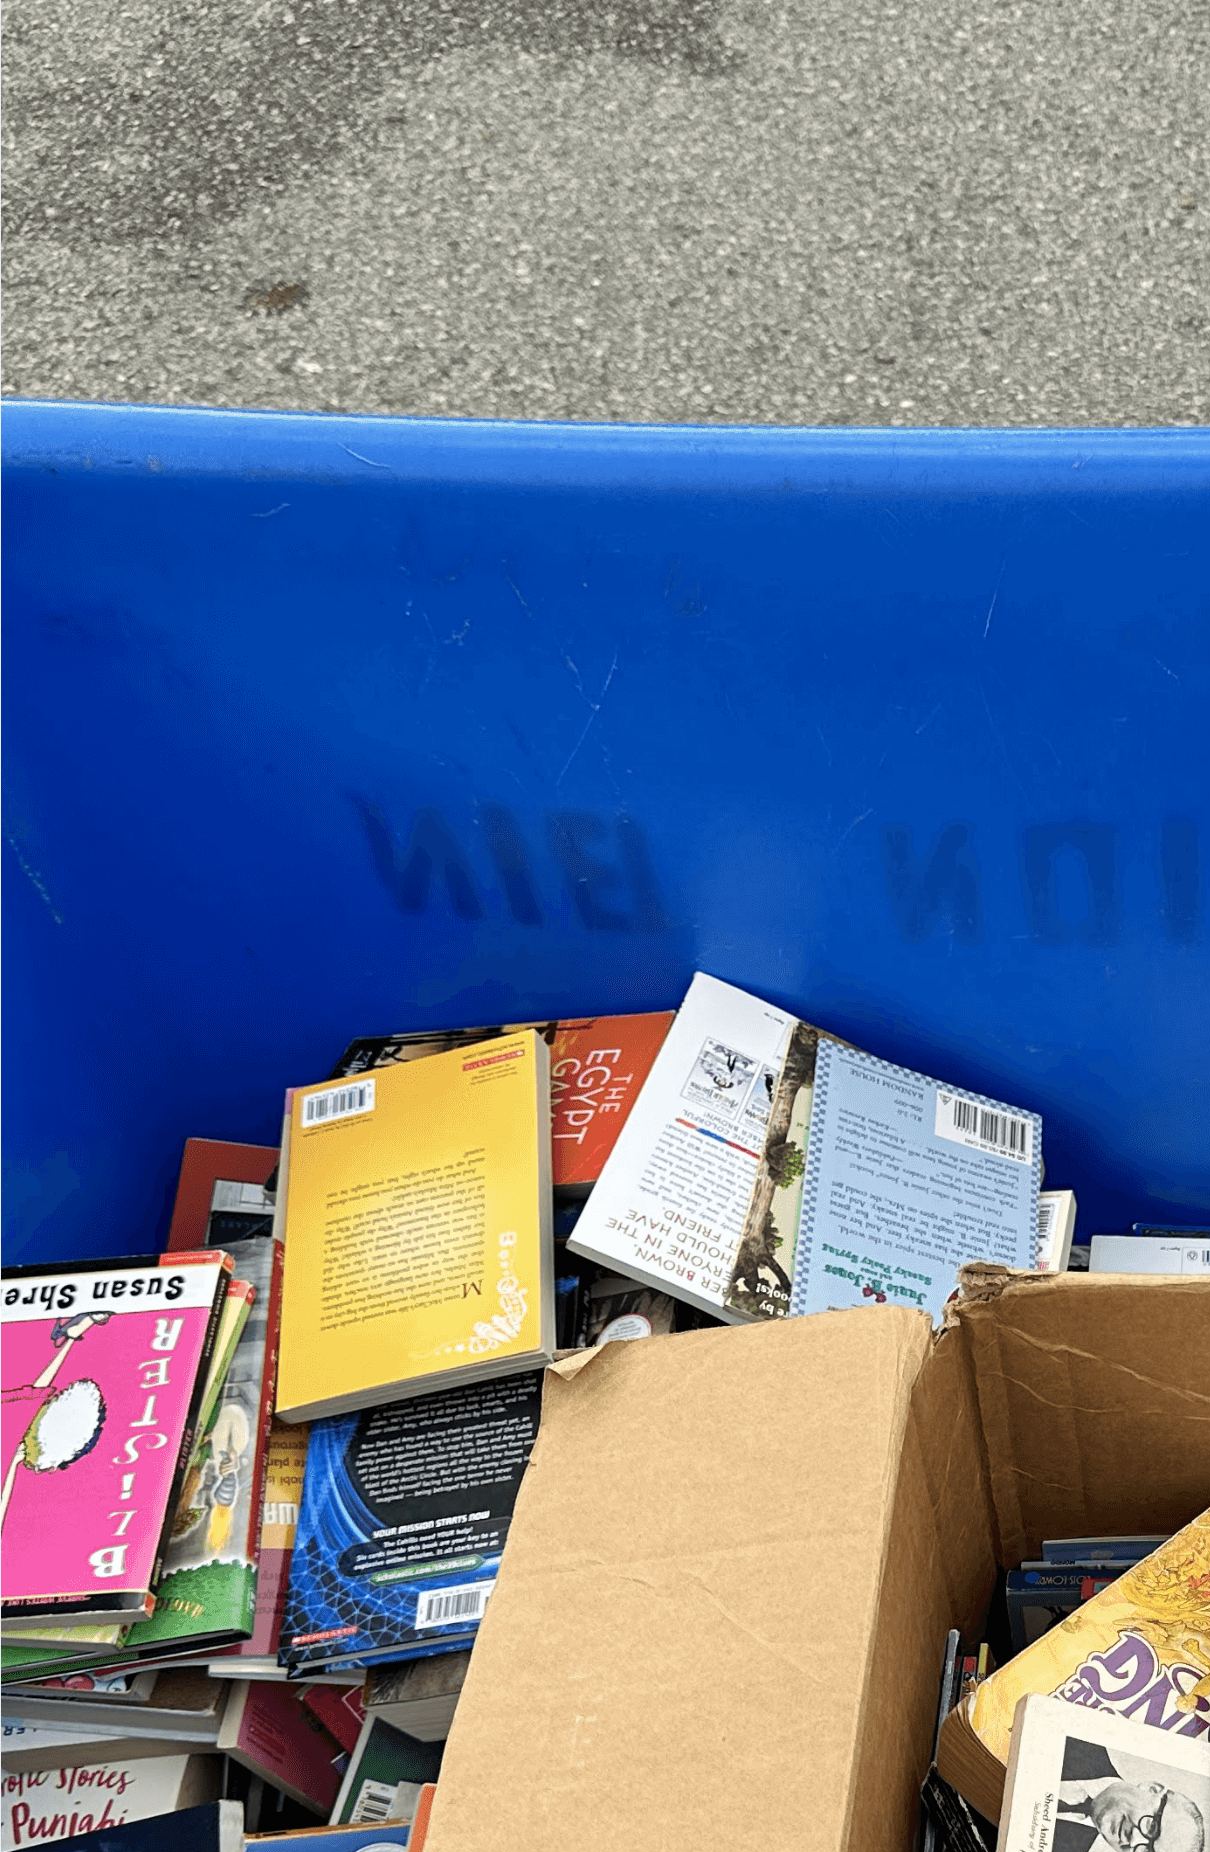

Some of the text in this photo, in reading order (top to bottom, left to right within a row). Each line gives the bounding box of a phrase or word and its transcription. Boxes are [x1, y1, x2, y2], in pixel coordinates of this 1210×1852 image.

[552, 1048, 622, 1149] EGYPT
[597, 1072, 633, 1114] THE
[604, 1216, 641, 1239] THE
[623, 1208, 672, 1236] HAVE
[822, 1263, 864, 1288] Jones
[91, 1274, 185, 1307] Susan
[886, 1282, 926, 1306] Junie
[1041, 1791, 1053, 1822] Sheed
